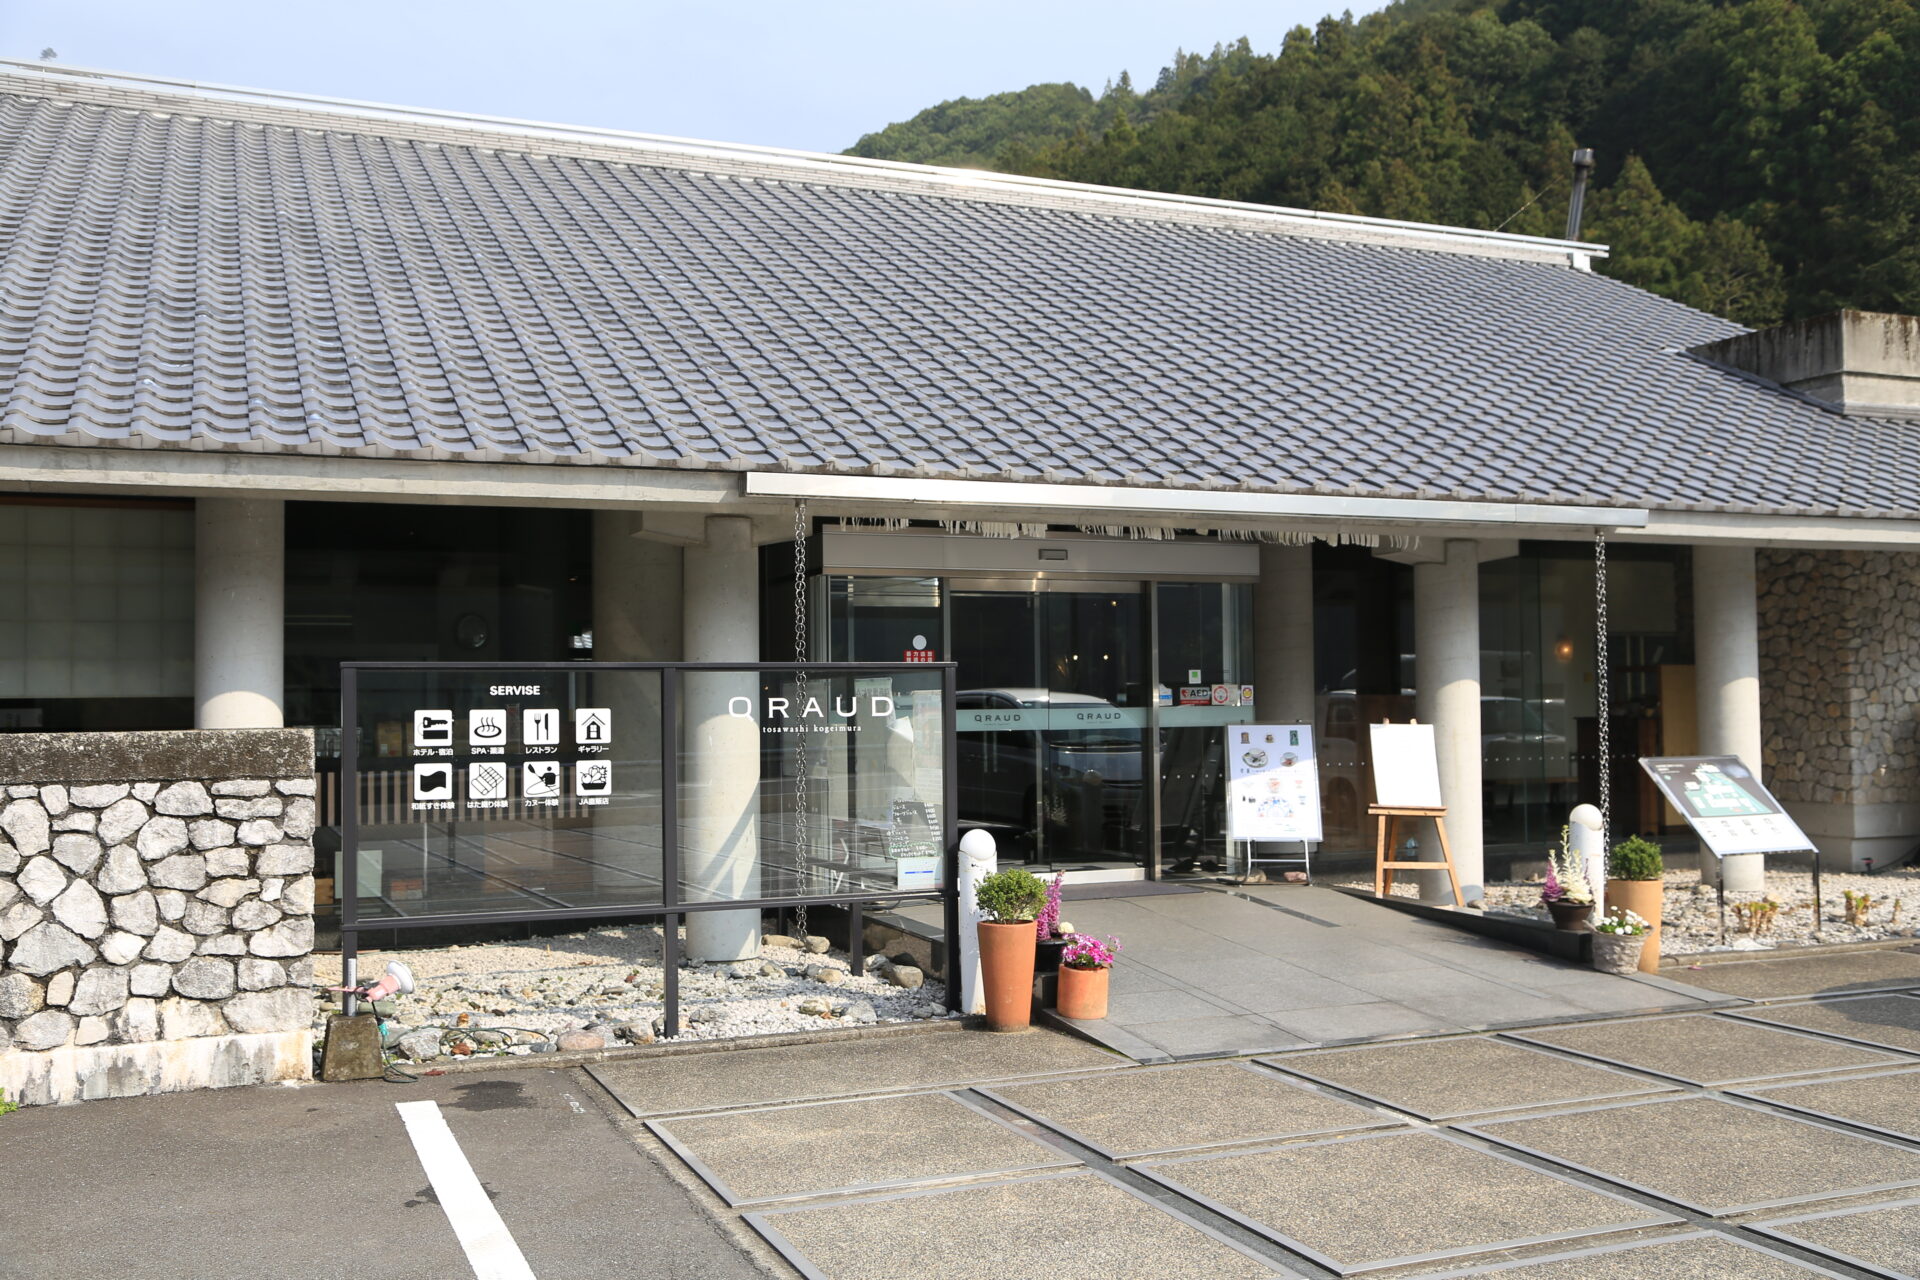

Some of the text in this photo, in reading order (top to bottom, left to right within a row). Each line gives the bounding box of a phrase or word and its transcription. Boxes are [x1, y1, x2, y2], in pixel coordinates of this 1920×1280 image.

[489, 685, 541, 696] SERVISE
[1189, 689, 1209, 698] AED
[728, 696, 894, 722] QRAUD
[974, 714, 1021, 723] QRAUD
[1076, 712, 1122, 721] QRAUD
[762, 724, 862, 734] tosawashi kogeimura
[525, 746, 558, 754] レストラン
[577, 745, 610, 753] ギャラリー
[525, 798, 559, 807] カヌー体験
